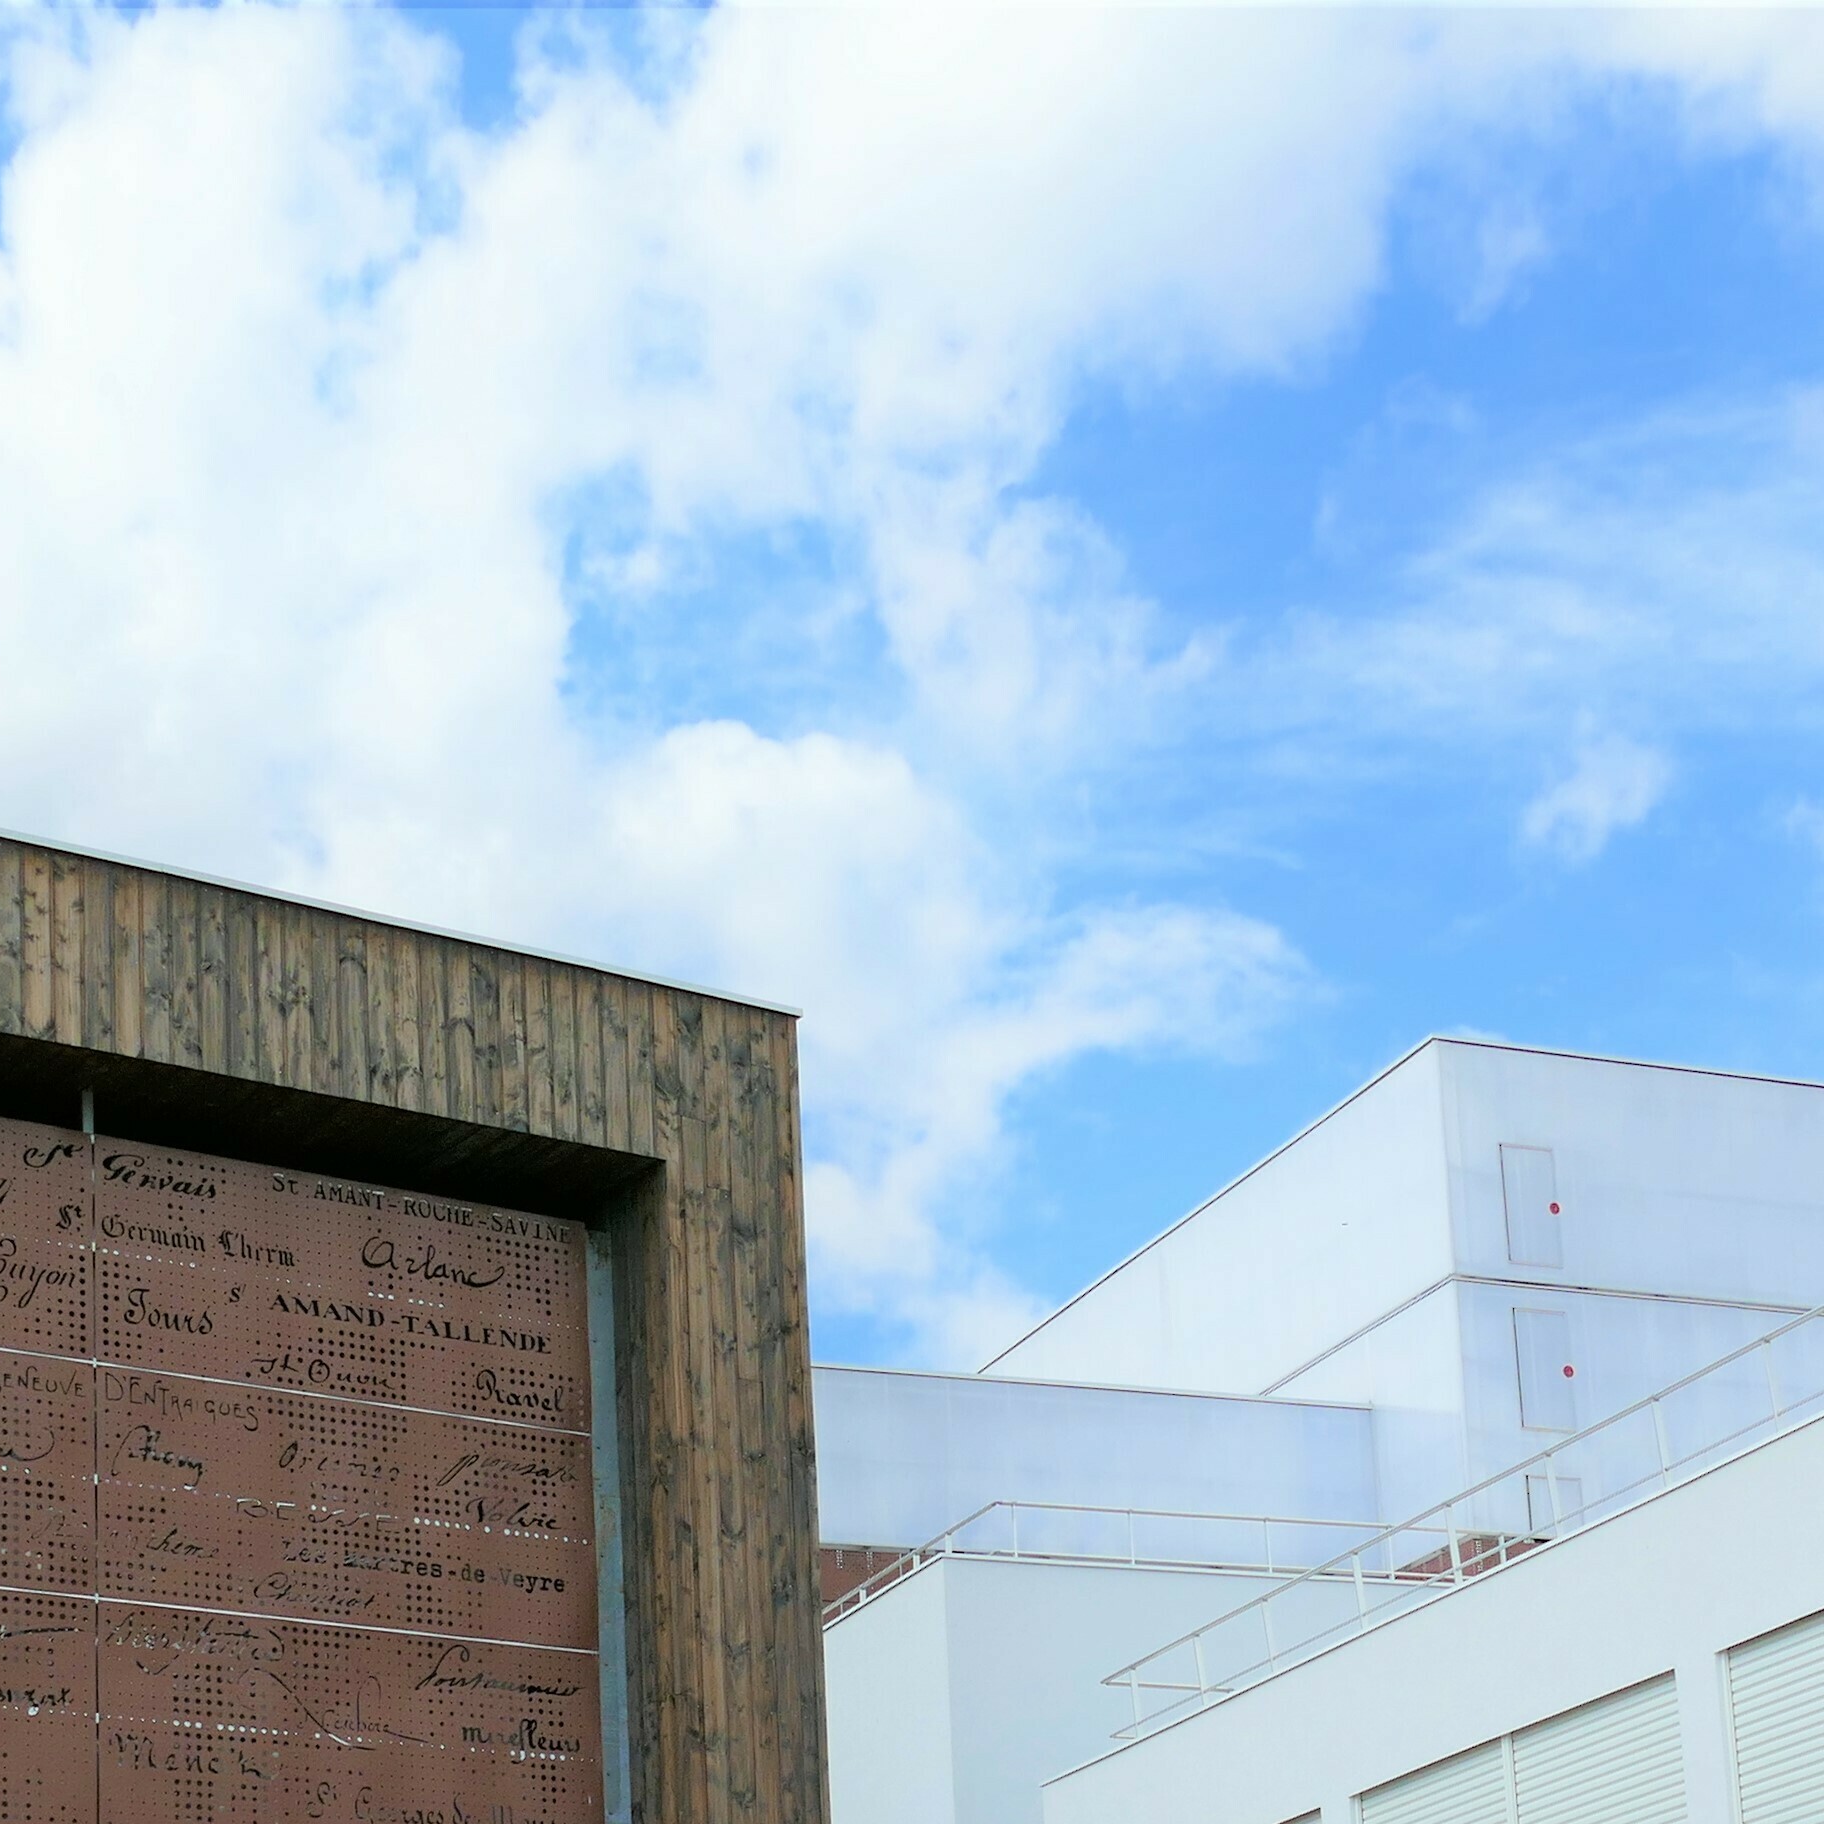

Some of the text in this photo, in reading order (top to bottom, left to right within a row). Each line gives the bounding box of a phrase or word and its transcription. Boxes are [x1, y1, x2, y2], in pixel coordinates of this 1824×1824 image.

[102, 1153, 218, 1199] Gervais
[100, 1213, 207, 1253] Germain
[124, 1287, 214, 1336] Tours
[268, 1292, 555, 1354] AMAND-TALLENDE
